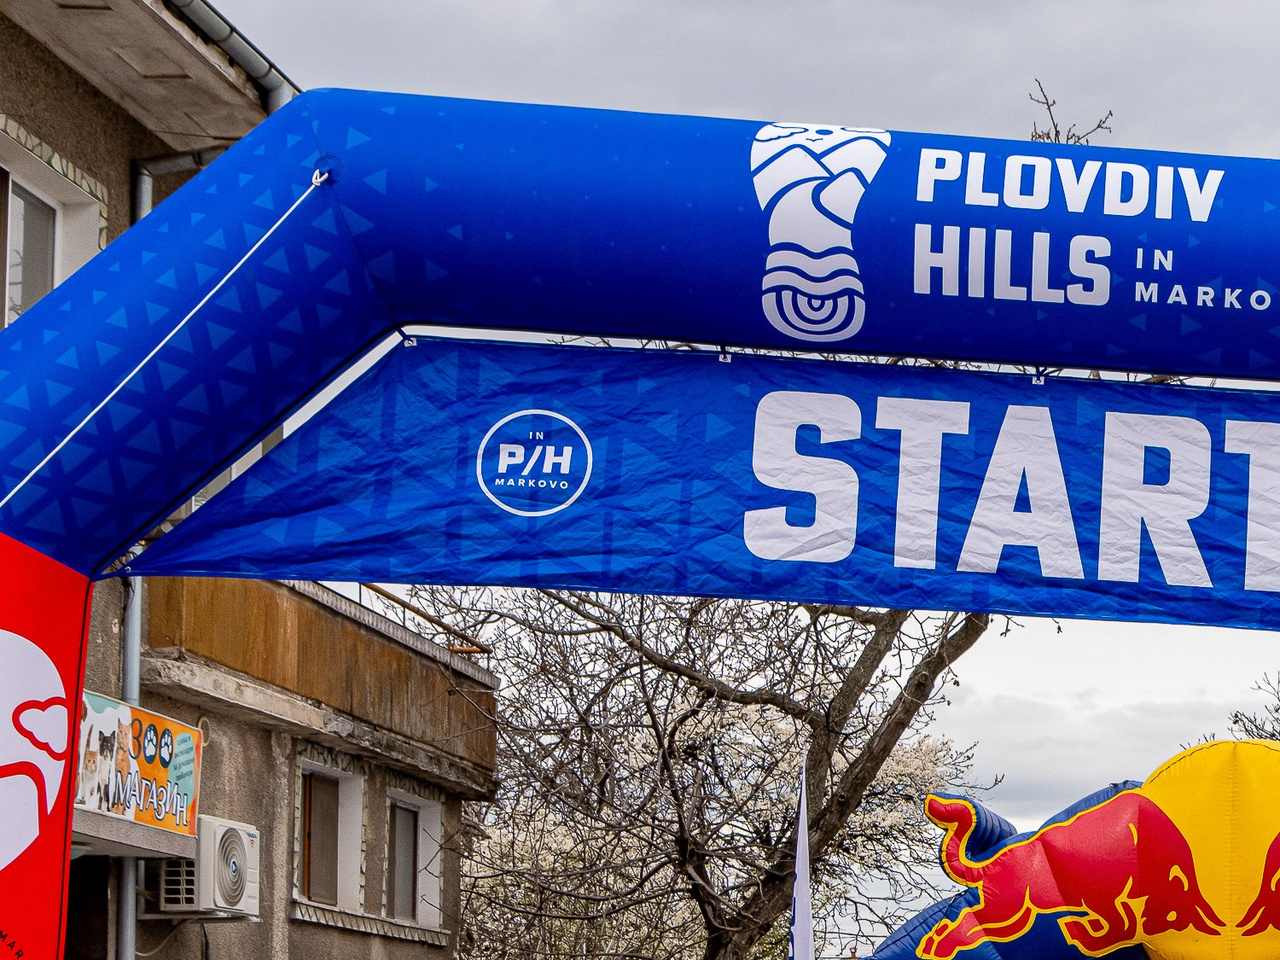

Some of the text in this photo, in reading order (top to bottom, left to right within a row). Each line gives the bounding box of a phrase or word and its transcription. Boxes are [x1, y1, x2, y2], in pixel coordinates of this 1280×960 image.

[916, 148, 1225, 222] PLOVDIV
[913, 224, 1111, 306] HILLS
[1136, 247, 1173, 272] IN
[529, 431, 544, 440] IN
[498, 443, 573, 476] P/H
[494, 478, 569, 490] MARKOVO
[115, 770, 188, 826] МАГАЗИН
